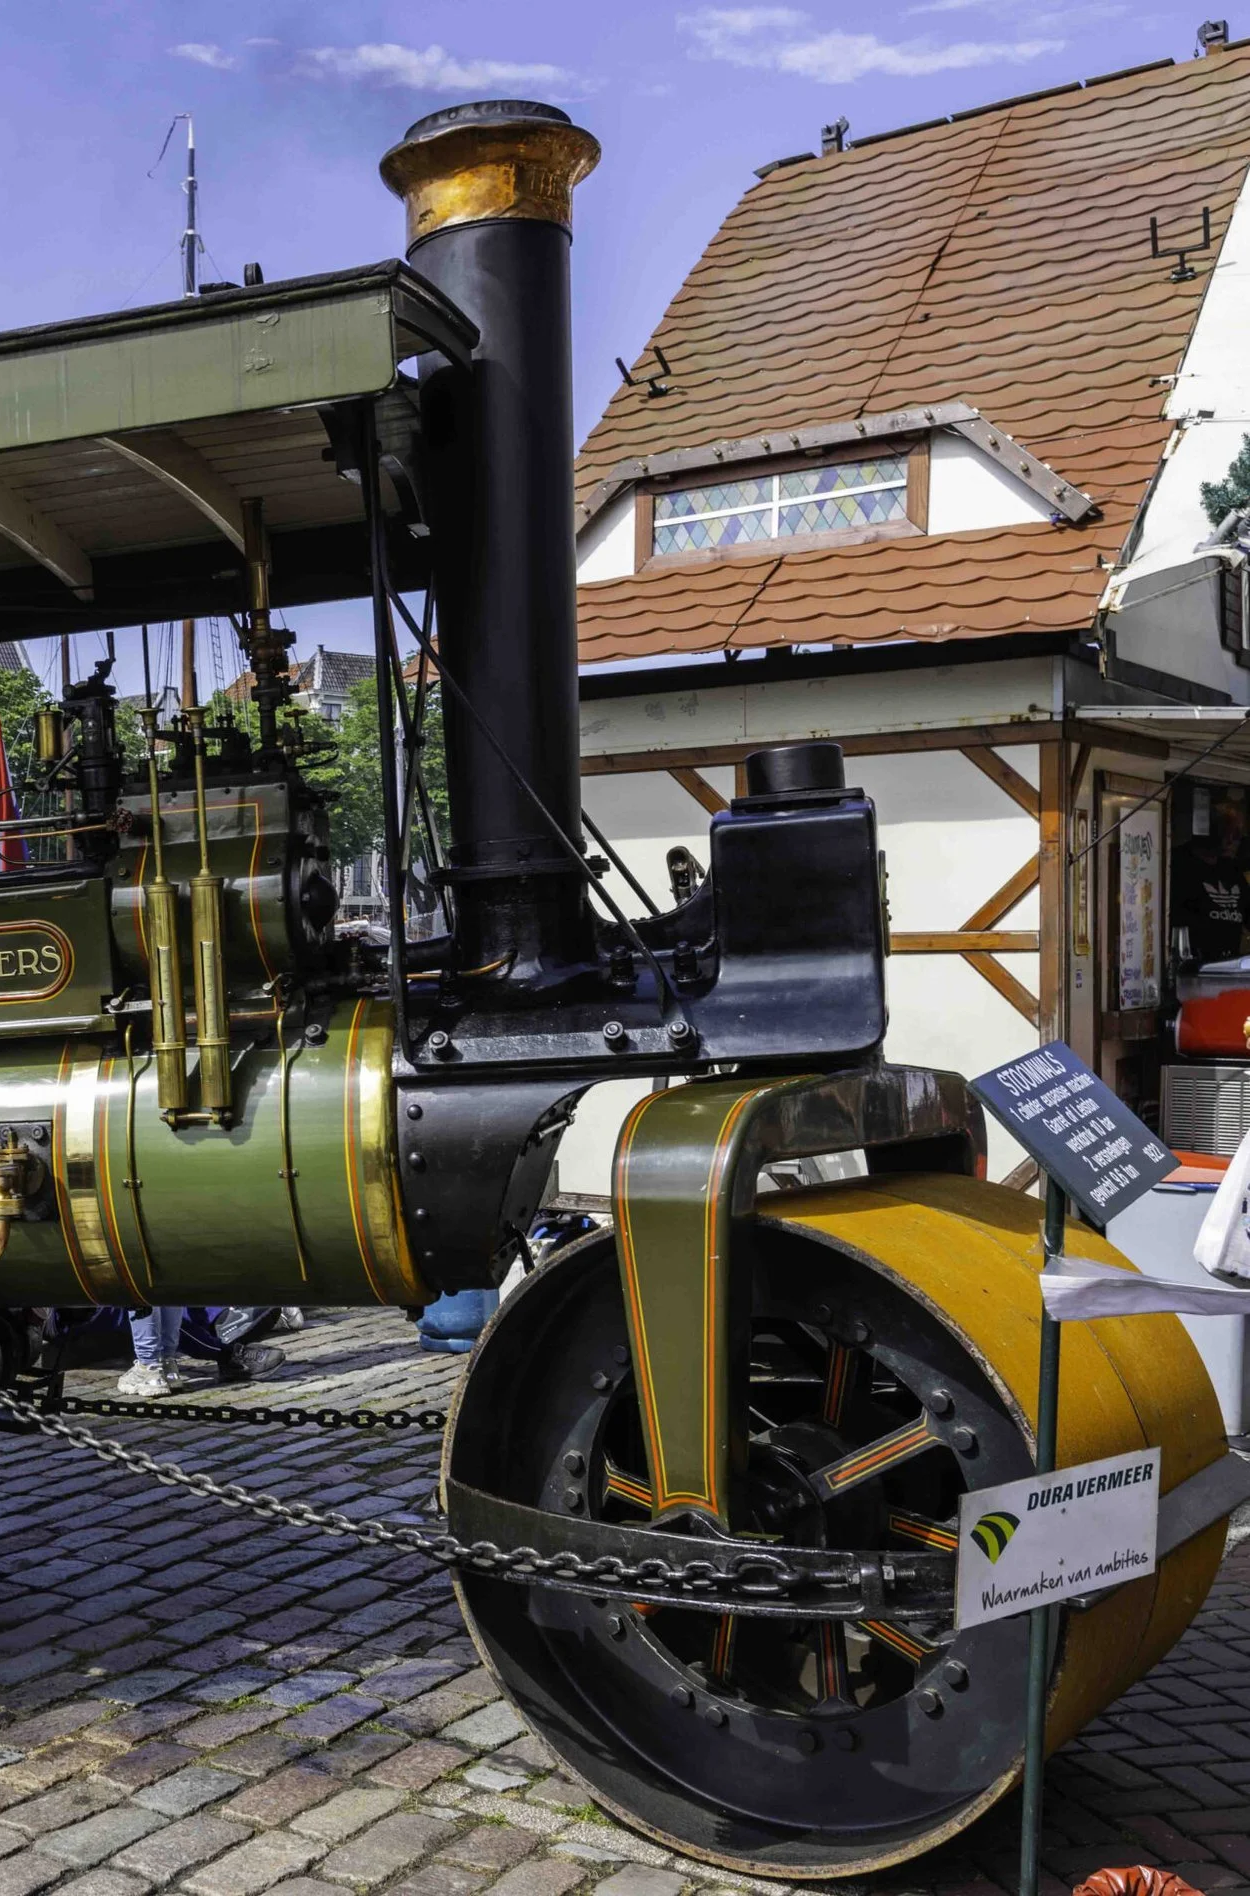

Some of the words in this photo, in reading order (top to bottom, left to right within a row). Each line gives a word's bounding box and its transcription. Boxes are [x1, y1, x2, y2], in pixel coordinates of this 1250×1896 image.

[996, 1050, 1067, 1097] STOOMWALS
[1009, 1107, 1024, 1123] 1
[1017, 1098, 1046, 1121] cilinder
[1065, 1071, 1095, 1094] machine
[1042, 1110, 1072, 1135] Garret
[1069, 1097, 1100, 1119] Leiston
[1065, 1125, 1099, 1153] werkdruk
[1089, 1119, 1107, 1137] 10
[1096, 1116, 1117, 1132] bar
[1082, 1155, 1099, 1172] 2
[1089, 1175, 1120, 1207] gewicht
[1119, 1164, 1141, 1179] ton
[1142, 1142, 1166, 1163] 1922
[1027, 1483, 1074, 1511] DURA
[1076, 1462, 1154, 1498] VERMEER
[981, 1571, 1064, 1611] Waarmaken
[1067, 1566, 1091, 1585] van
[1094, 1549, 1149, 1577] ambities
